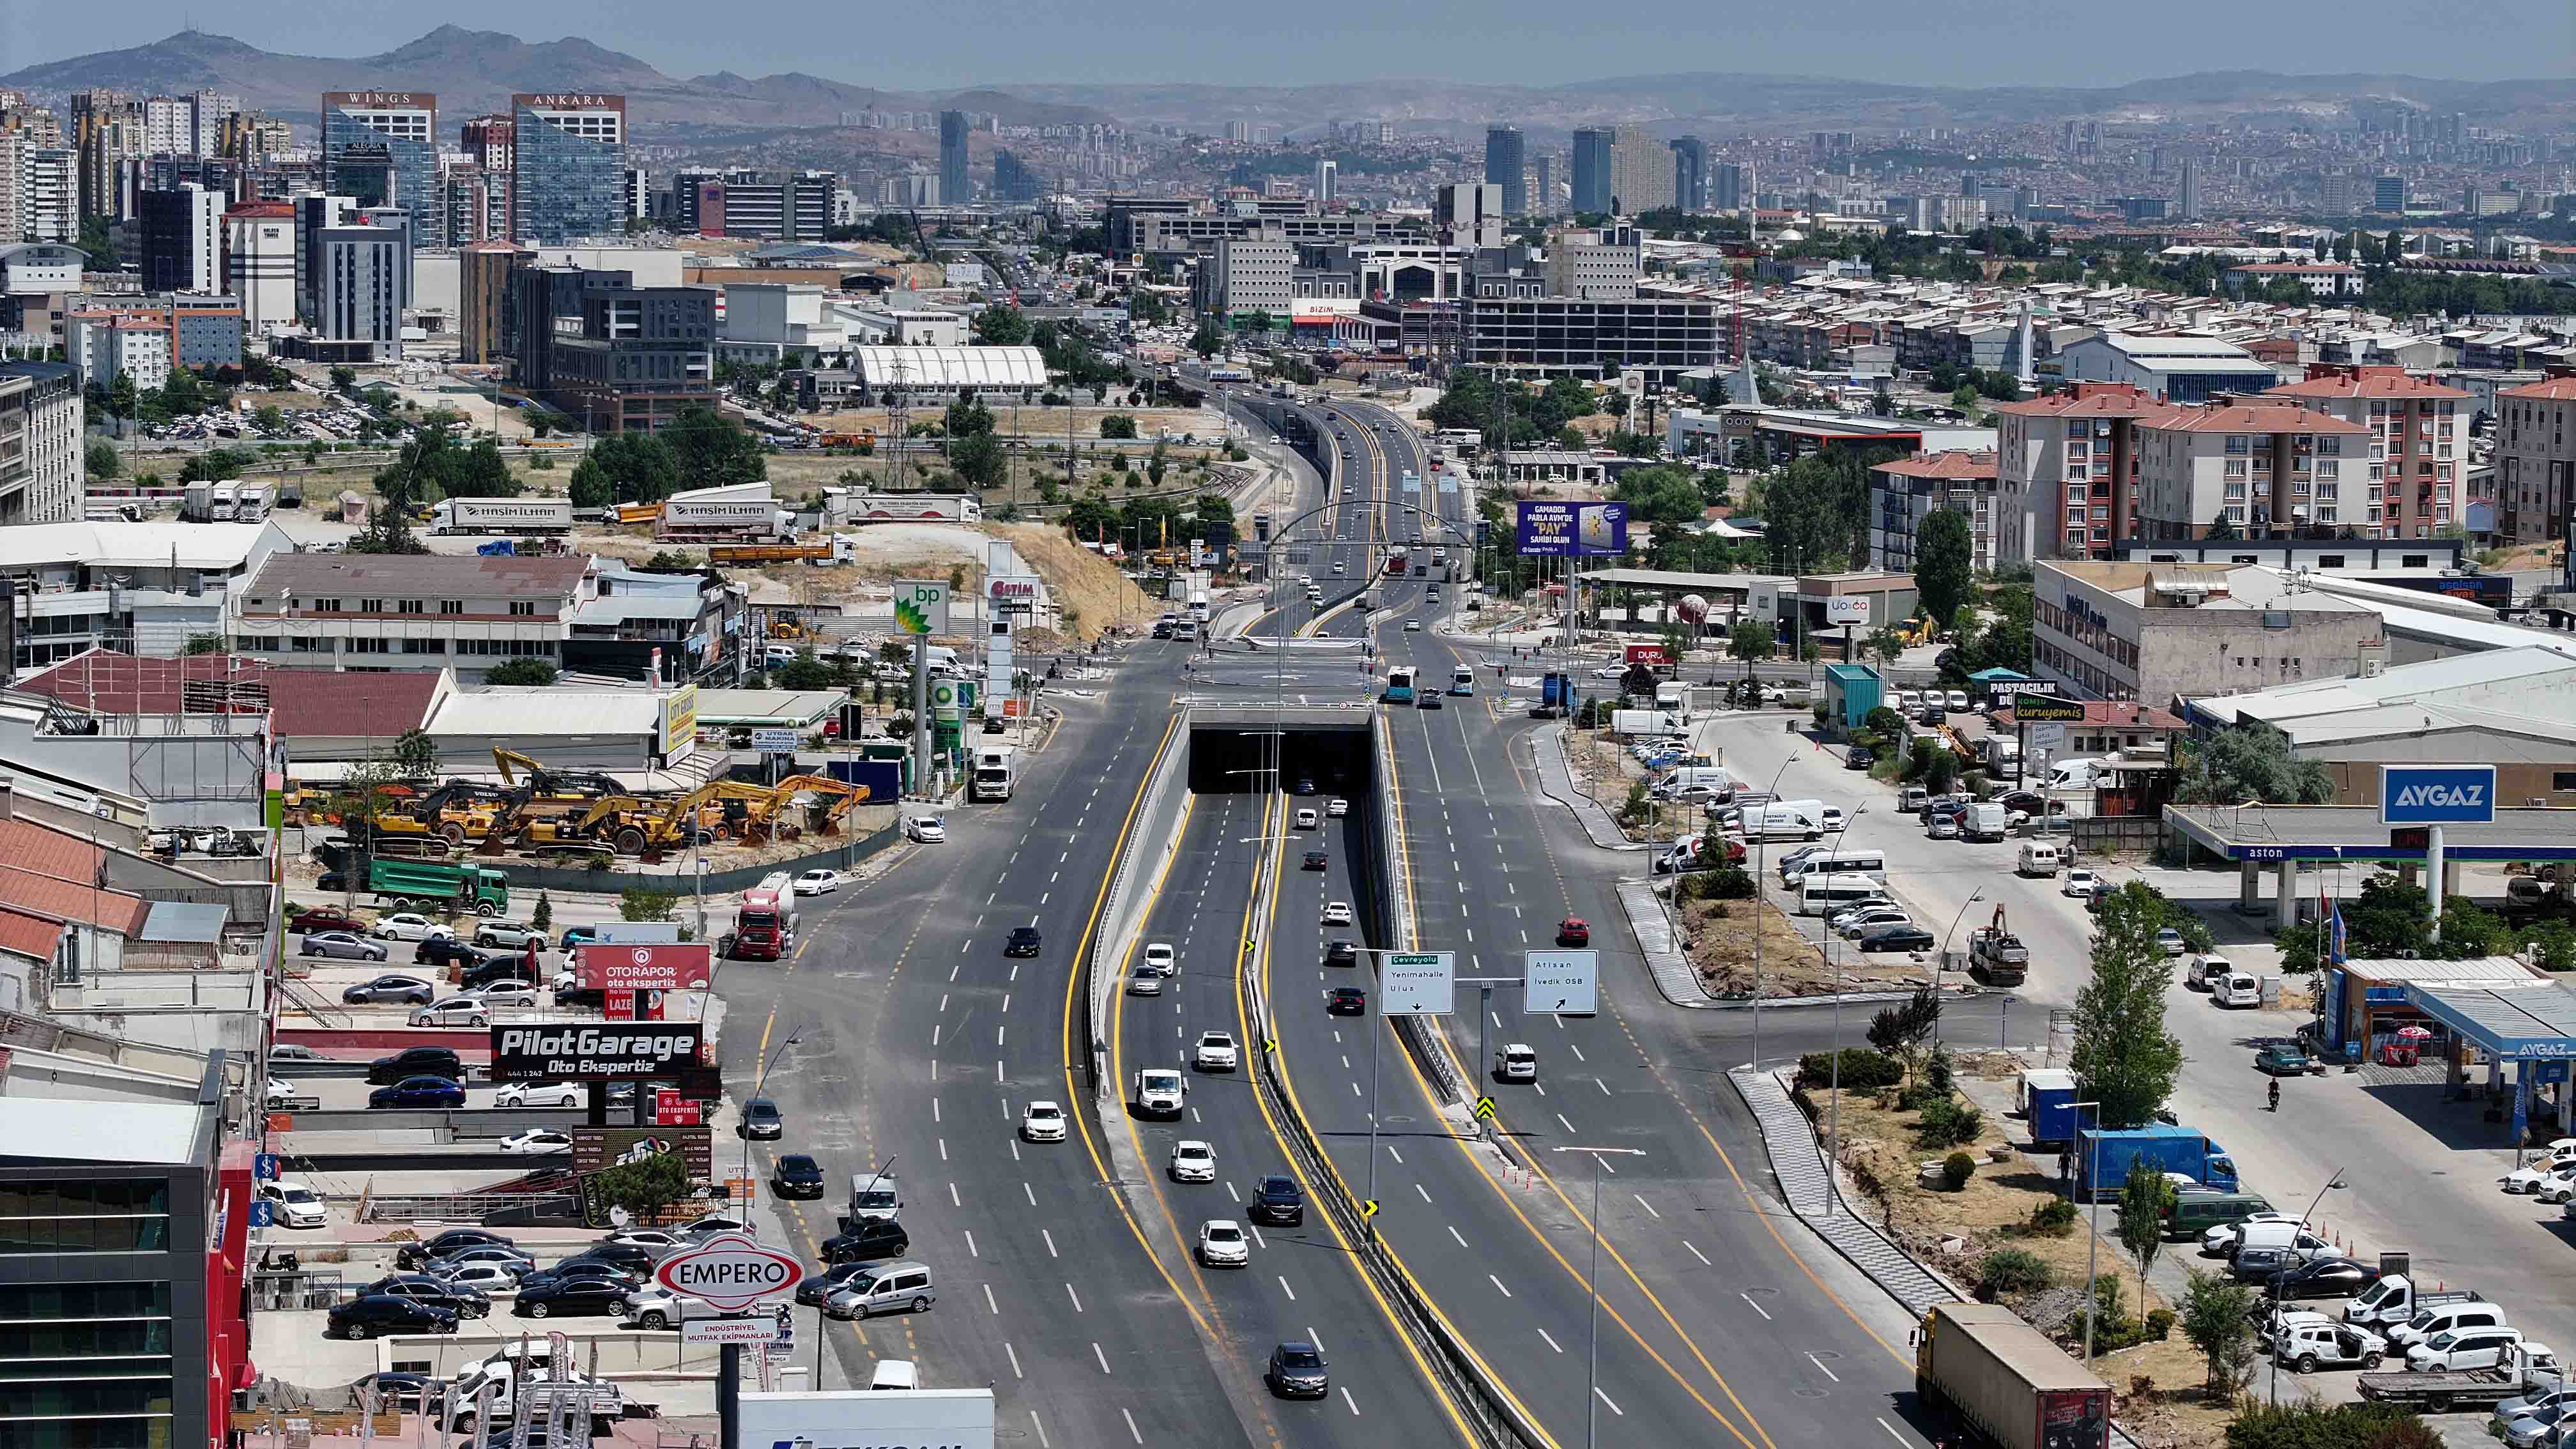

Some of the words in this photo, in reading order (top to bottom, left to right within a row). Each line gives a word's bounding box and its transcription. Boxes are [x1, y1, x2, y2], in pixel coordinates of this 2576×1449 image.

[349, 93, 410, 103] WINGS
[533, 95, 605, 105] ANKARA
[2522, 316, 2567, 326] EKMEK
[481, 507, 517, 516] HAŞİM
[519, 507, 556, 516] İLHAN
[690, 505, 726, 516] HAŞİM
[728, 505, 765, 514] İLHAN
[1530, 535, 1551, 543] SAHİBİ
[916, 585, 940, 606] bp
[1990, 683, 2055, 693] PASTACILIK
[2395, 785, 2484, 806] AYGAZ
[2250, 848, 2283, 858] aston
[1393, 956, 1437, 964] Çevreyolu
[606, 967, 677, 976] OTORAPOR
[626, 978, 677, 989] ekspertiz
[609, 999, 632, 1011] LAZE
[2518, 1043, 2566, 1056] AYGAZ
[548, 1060, 576, 1073] Oto
[579, 1059, 656, 1076] Ekspertiz
[680, 1262, 785, 1284] EMPERO
[705, 1323, 756, 1332] ENDÜSTRİYEL
[721, 1332, 773, 1340] EKİPMANLARI
